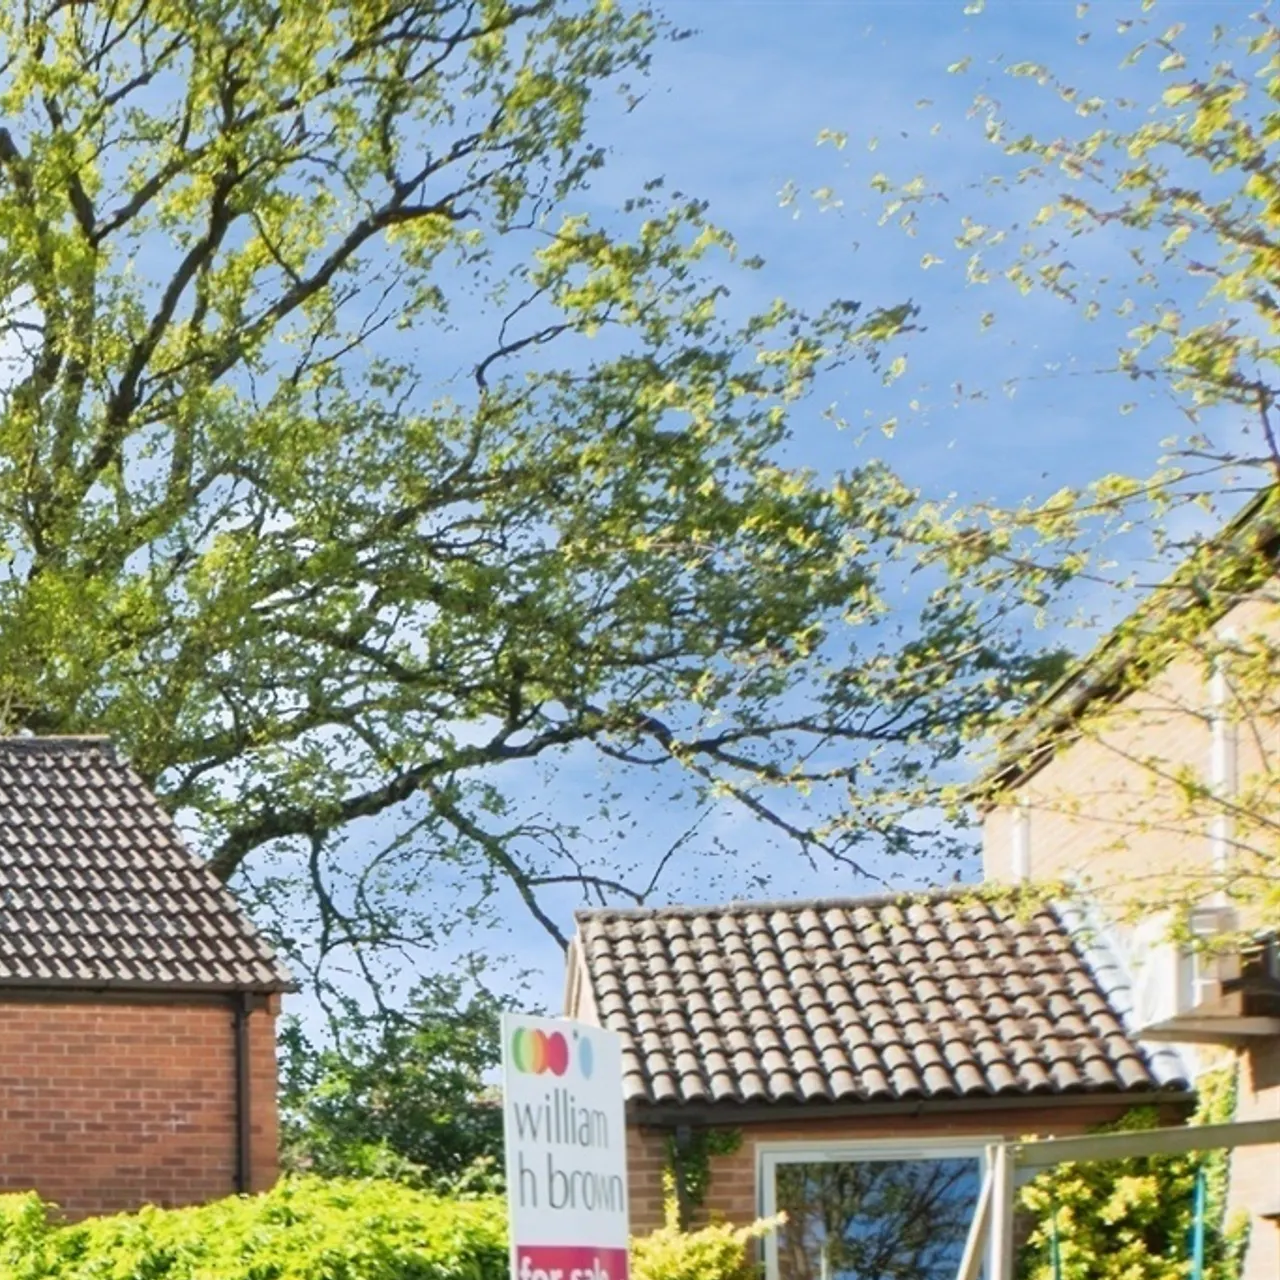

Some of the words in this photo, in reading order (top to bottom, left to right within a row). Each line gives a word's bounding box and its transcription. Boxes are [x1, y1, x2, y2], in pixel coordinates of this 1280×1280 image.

[513, 1088, 609, 1149] william
[518, 1150, 538, 1209] h
[547, 1152, 625, 1213] brown
